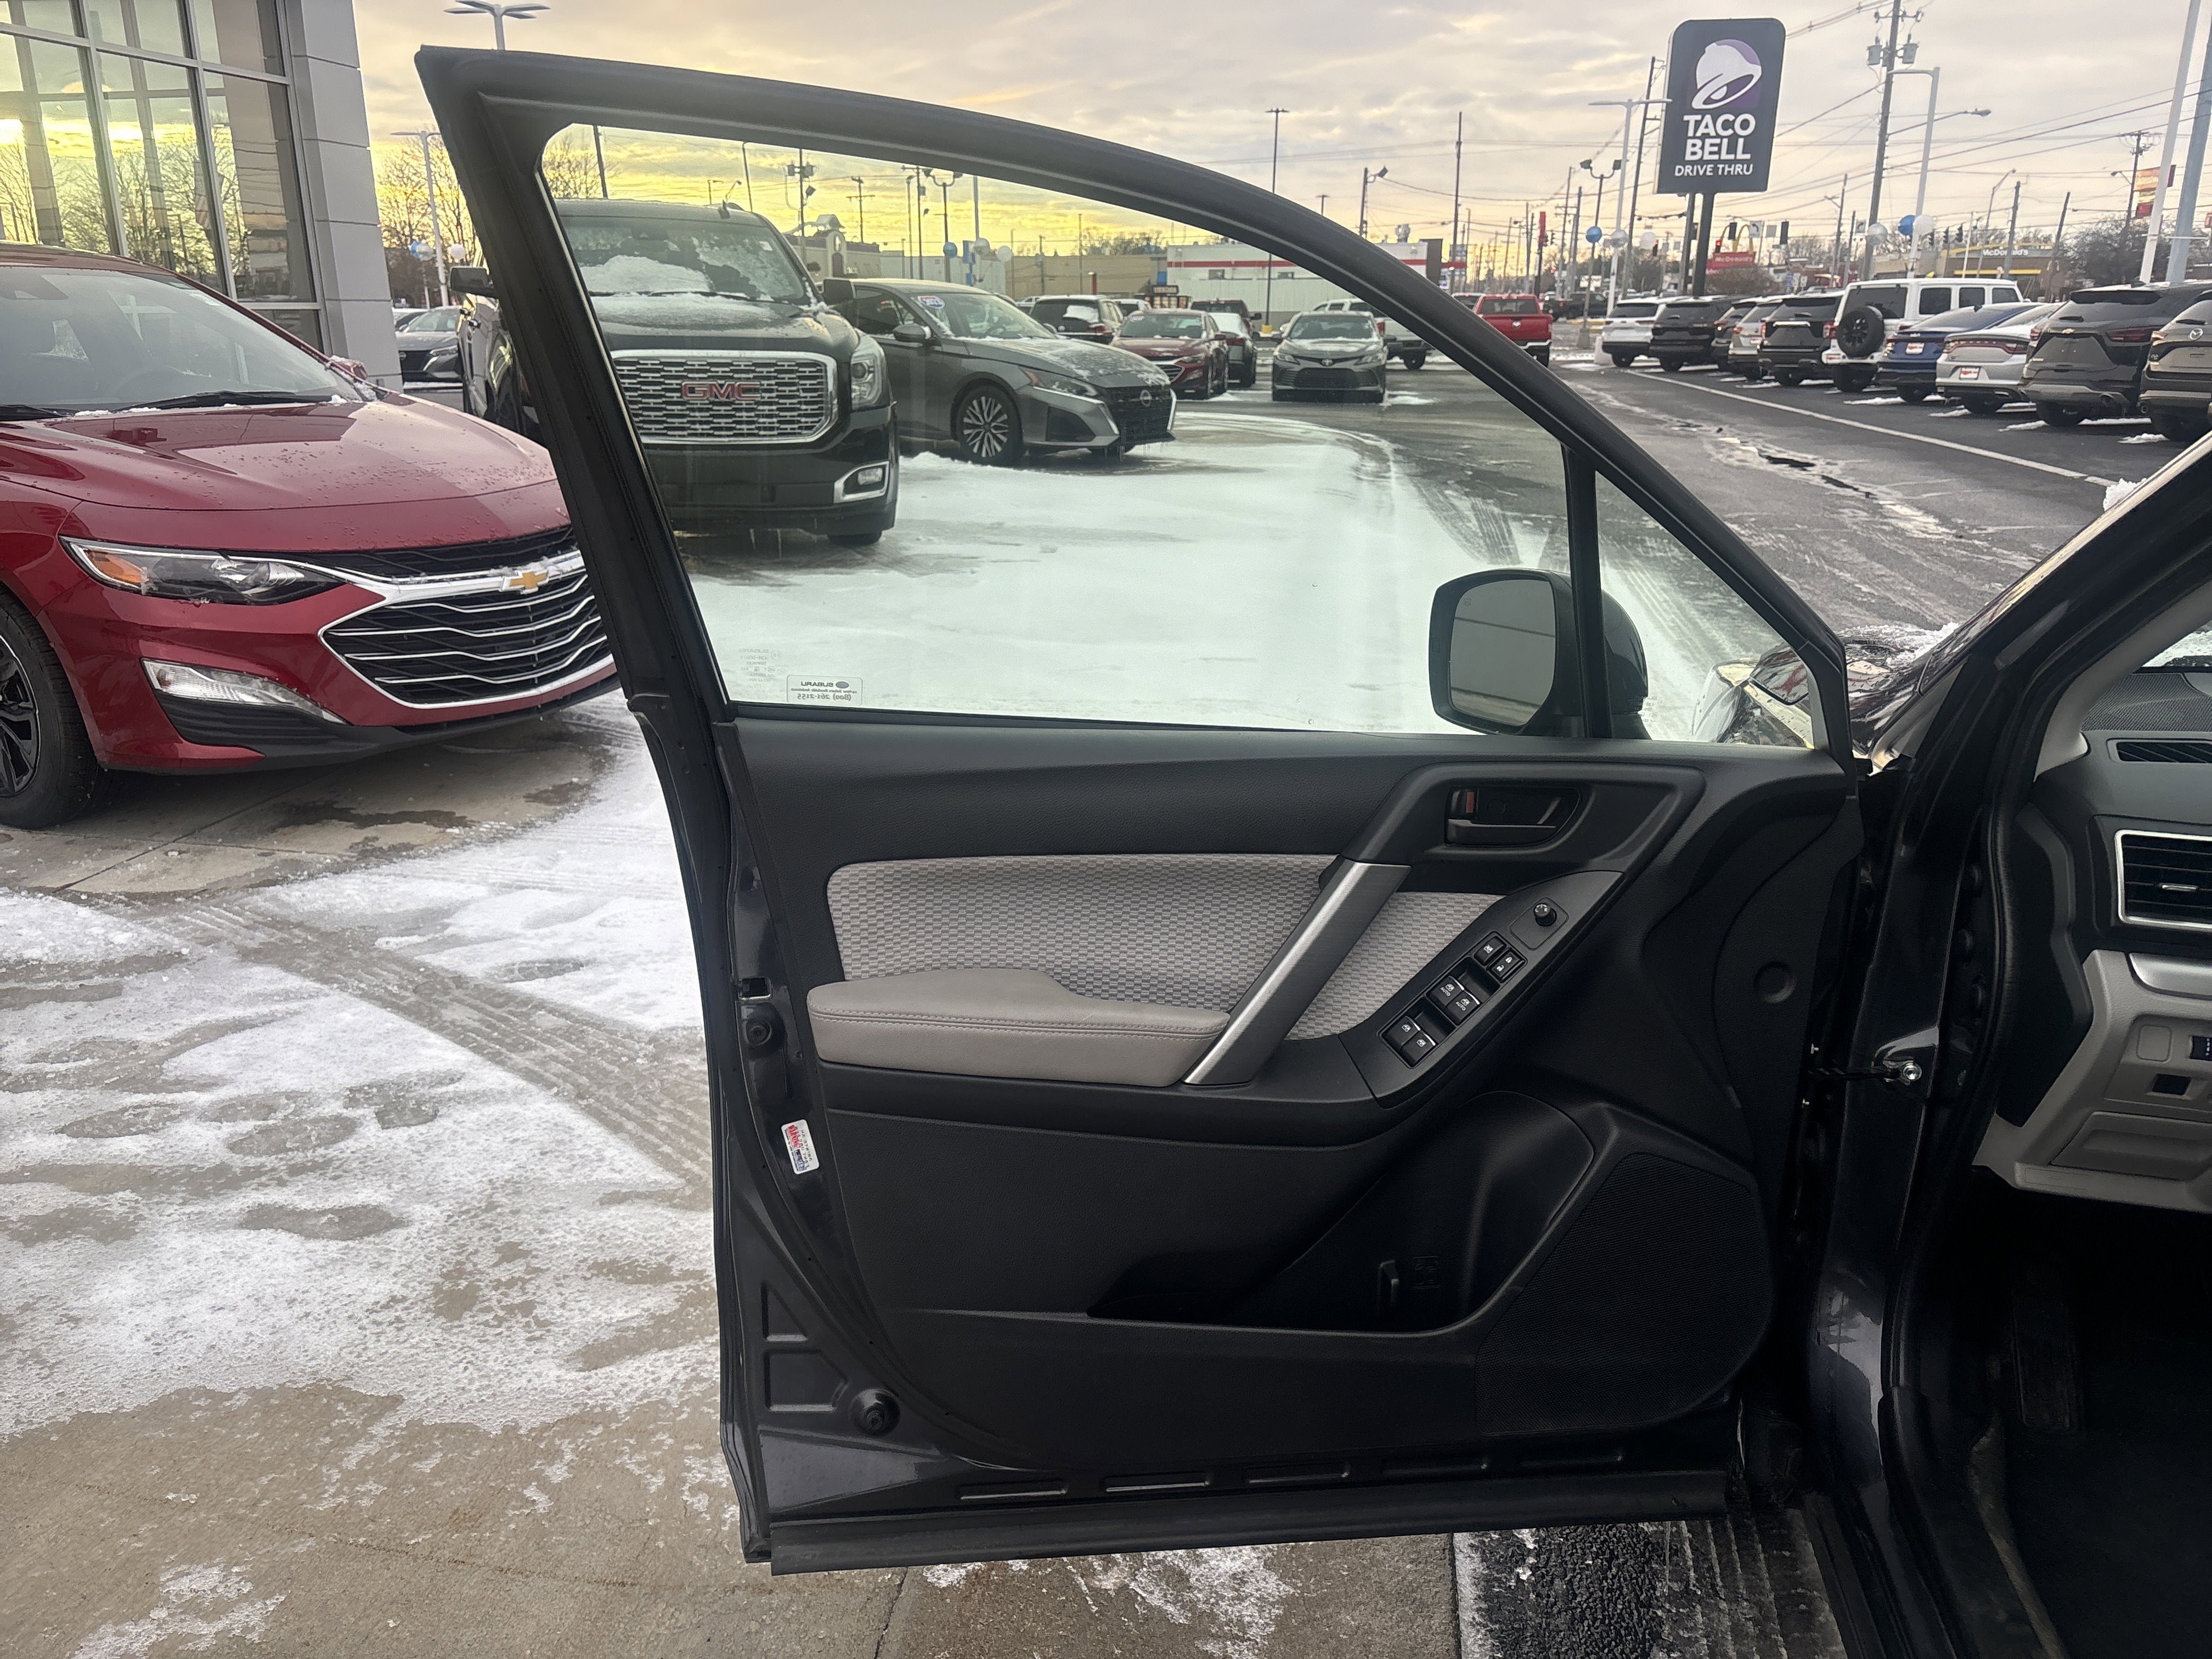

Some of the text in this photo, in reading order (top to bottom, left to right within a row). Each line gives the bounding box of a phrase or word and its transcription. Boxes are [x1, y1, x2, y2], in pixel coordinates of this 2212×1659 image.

[1683, 113, 1756, 137] TACO
[1684, 138, 1752, 161] BELL
[1674, 163, 1753, 177] DRIVE THRU
[681, 382, 761, 401] GMC
[1440, 987, 1451, 996] AUTO
[1455, 1001, 1466, 1011] AUTO
